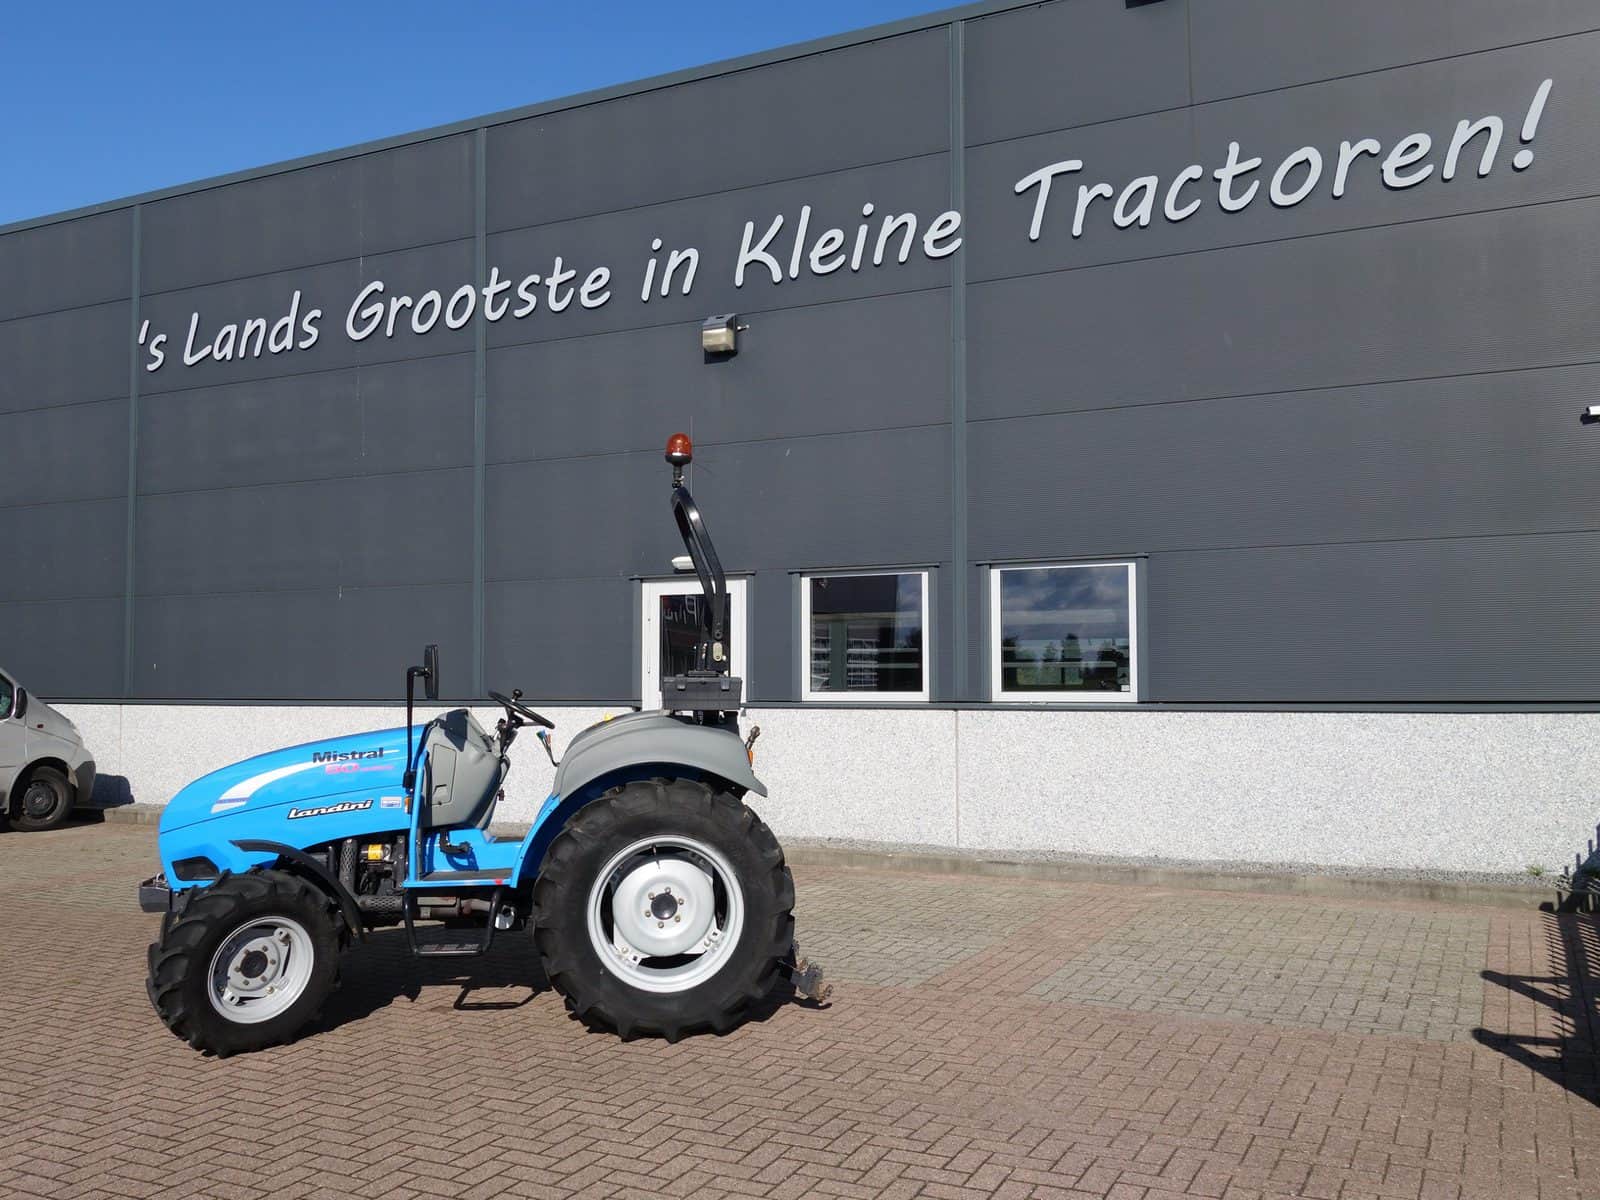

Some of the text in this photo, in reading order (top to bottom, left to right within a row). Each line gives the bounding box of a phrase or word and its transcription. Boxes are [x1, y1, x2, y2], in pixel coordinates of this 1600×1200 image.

[137, 78, 1553, 372] 's Lands Grootste in Kleine Tractoren!
[312, 747, 385, 763] Mistral
[287, 799, 374, 820] Landini
